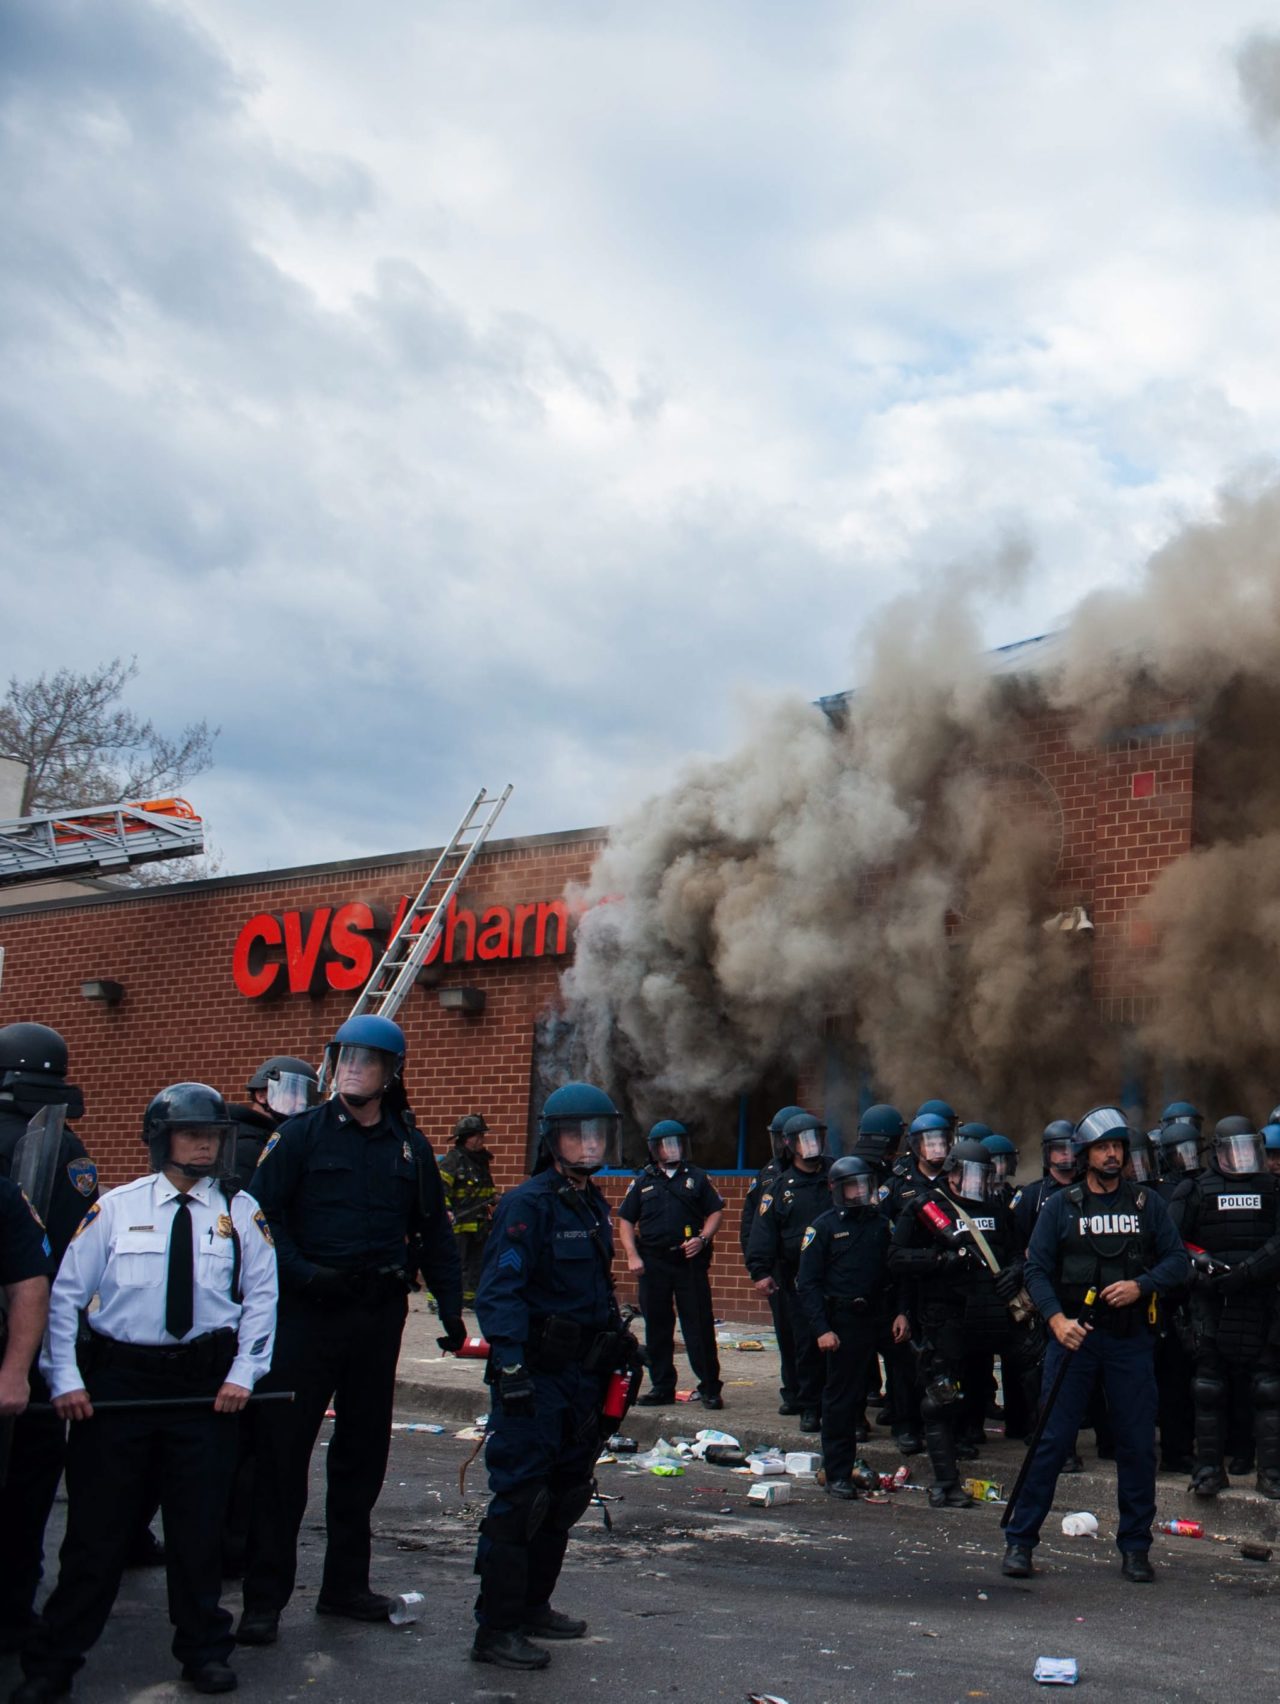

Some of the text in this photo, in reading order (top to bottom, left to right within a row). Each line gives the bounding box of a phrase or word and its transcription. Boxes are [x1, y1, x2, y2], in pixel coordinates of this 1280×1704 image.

[1220, 1196, 1260, 1207] POLICE
[959, 1219, 995, 1230] PICE
[1079, 1213, 1140, 1236] POLICE
